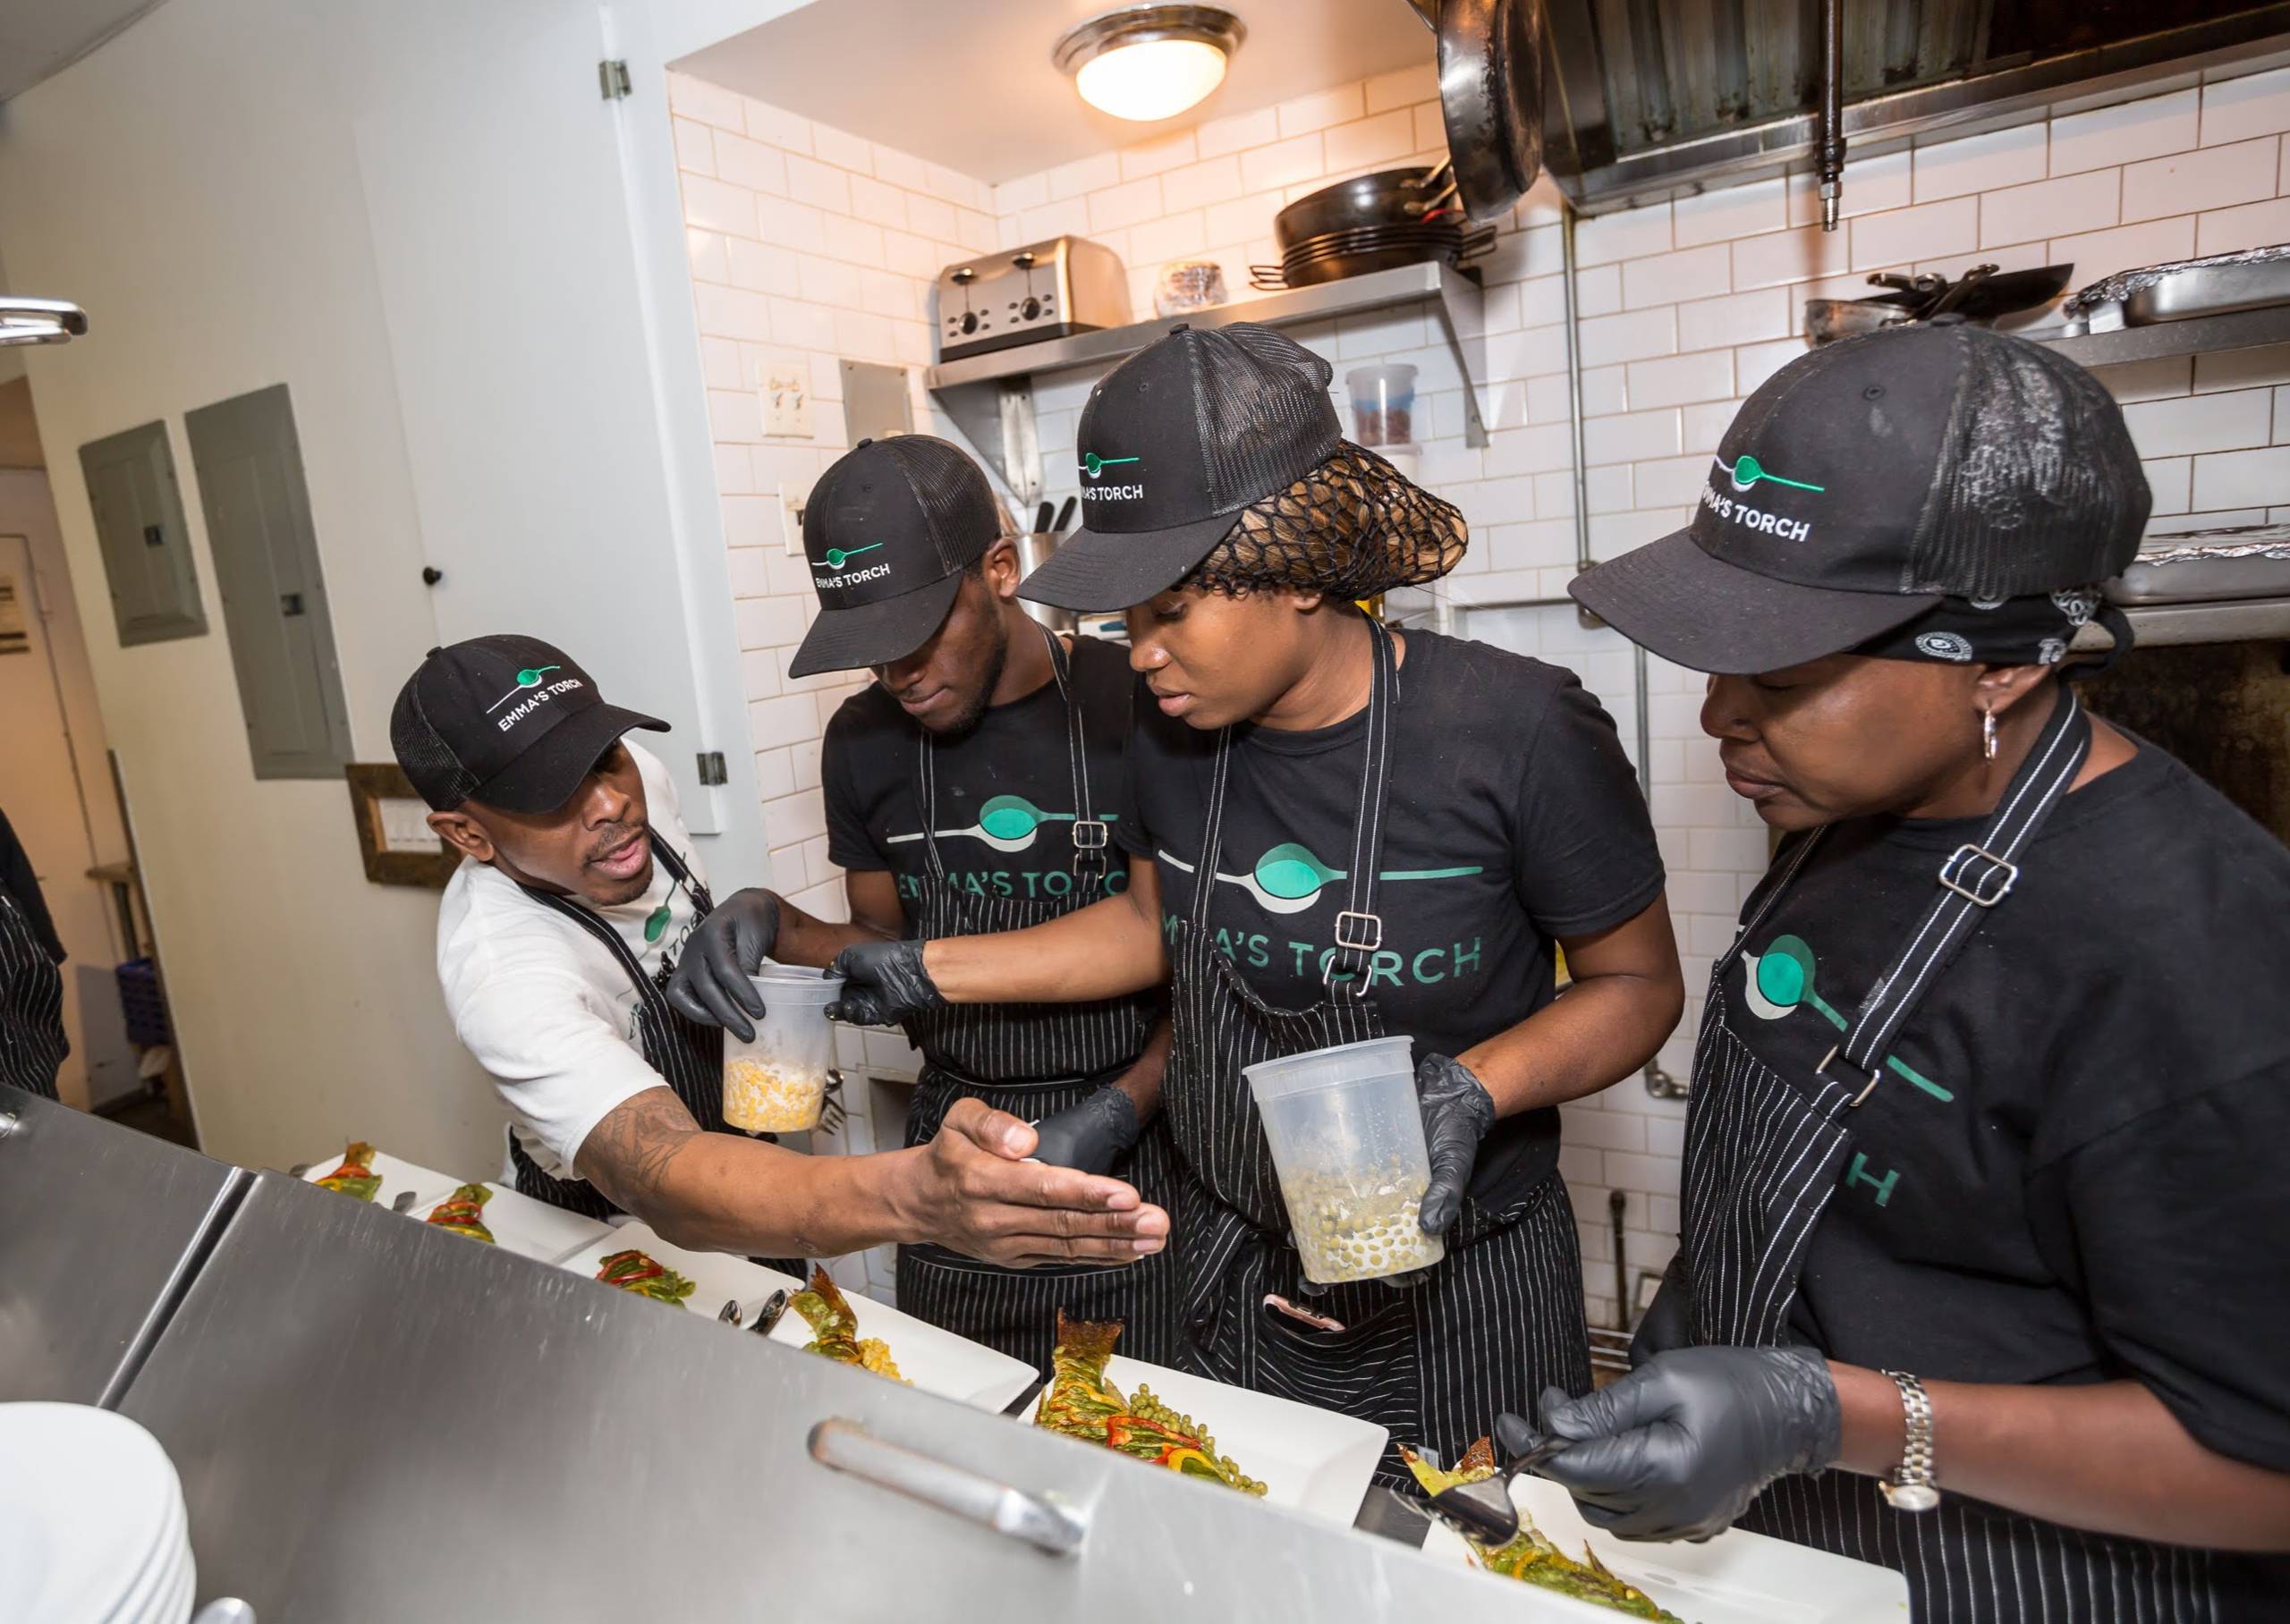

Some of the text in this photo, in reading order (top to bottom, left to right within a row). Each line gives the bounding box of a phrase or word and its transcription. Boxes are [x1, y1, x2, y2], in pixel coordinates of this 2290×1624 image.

[1097, 484, 1143, 501] TORCH
[1734, 503, 1811, 542] TORCH
[843, 562, 891, 586] TORCH
[497, 679, 583, 732] EMMA'S TORCH
[1022, 871, 1126, 898] TOC
